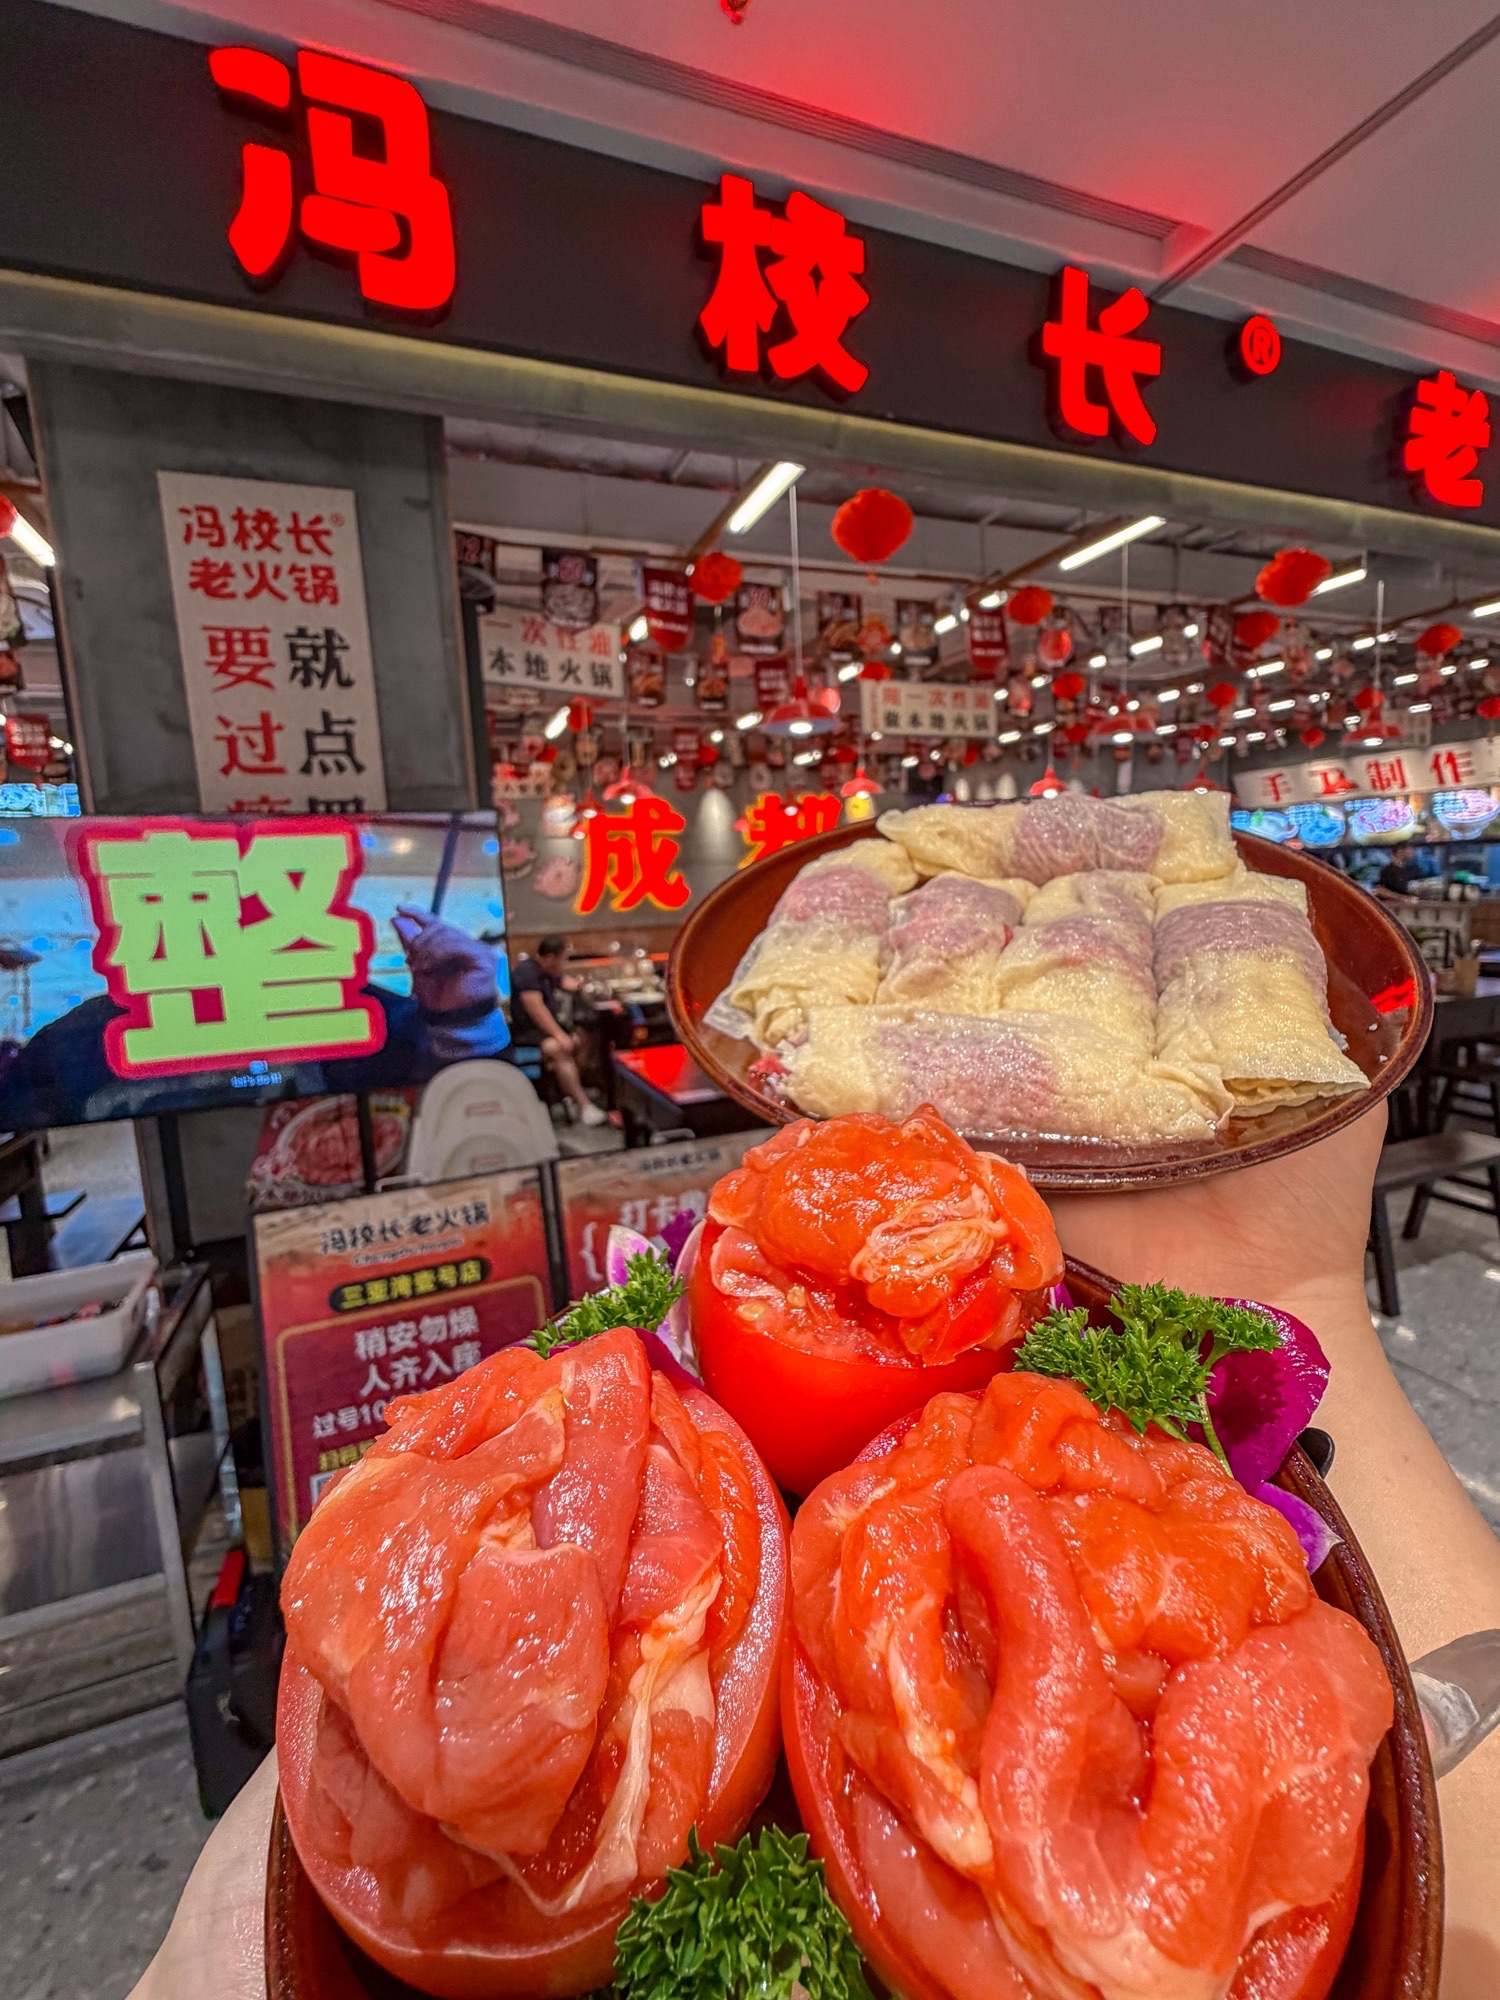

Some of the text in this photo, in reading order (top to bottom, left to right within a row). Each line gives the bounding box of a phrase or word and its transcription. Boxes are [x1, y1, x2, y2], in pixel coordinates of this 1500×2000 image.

[178, 505, 333, 556] 冯校长
[188, 557, 339, 606] 老火锅
[488, 646, 613, 689] 本地火锅
[97, 829, 371, 1063] 整
